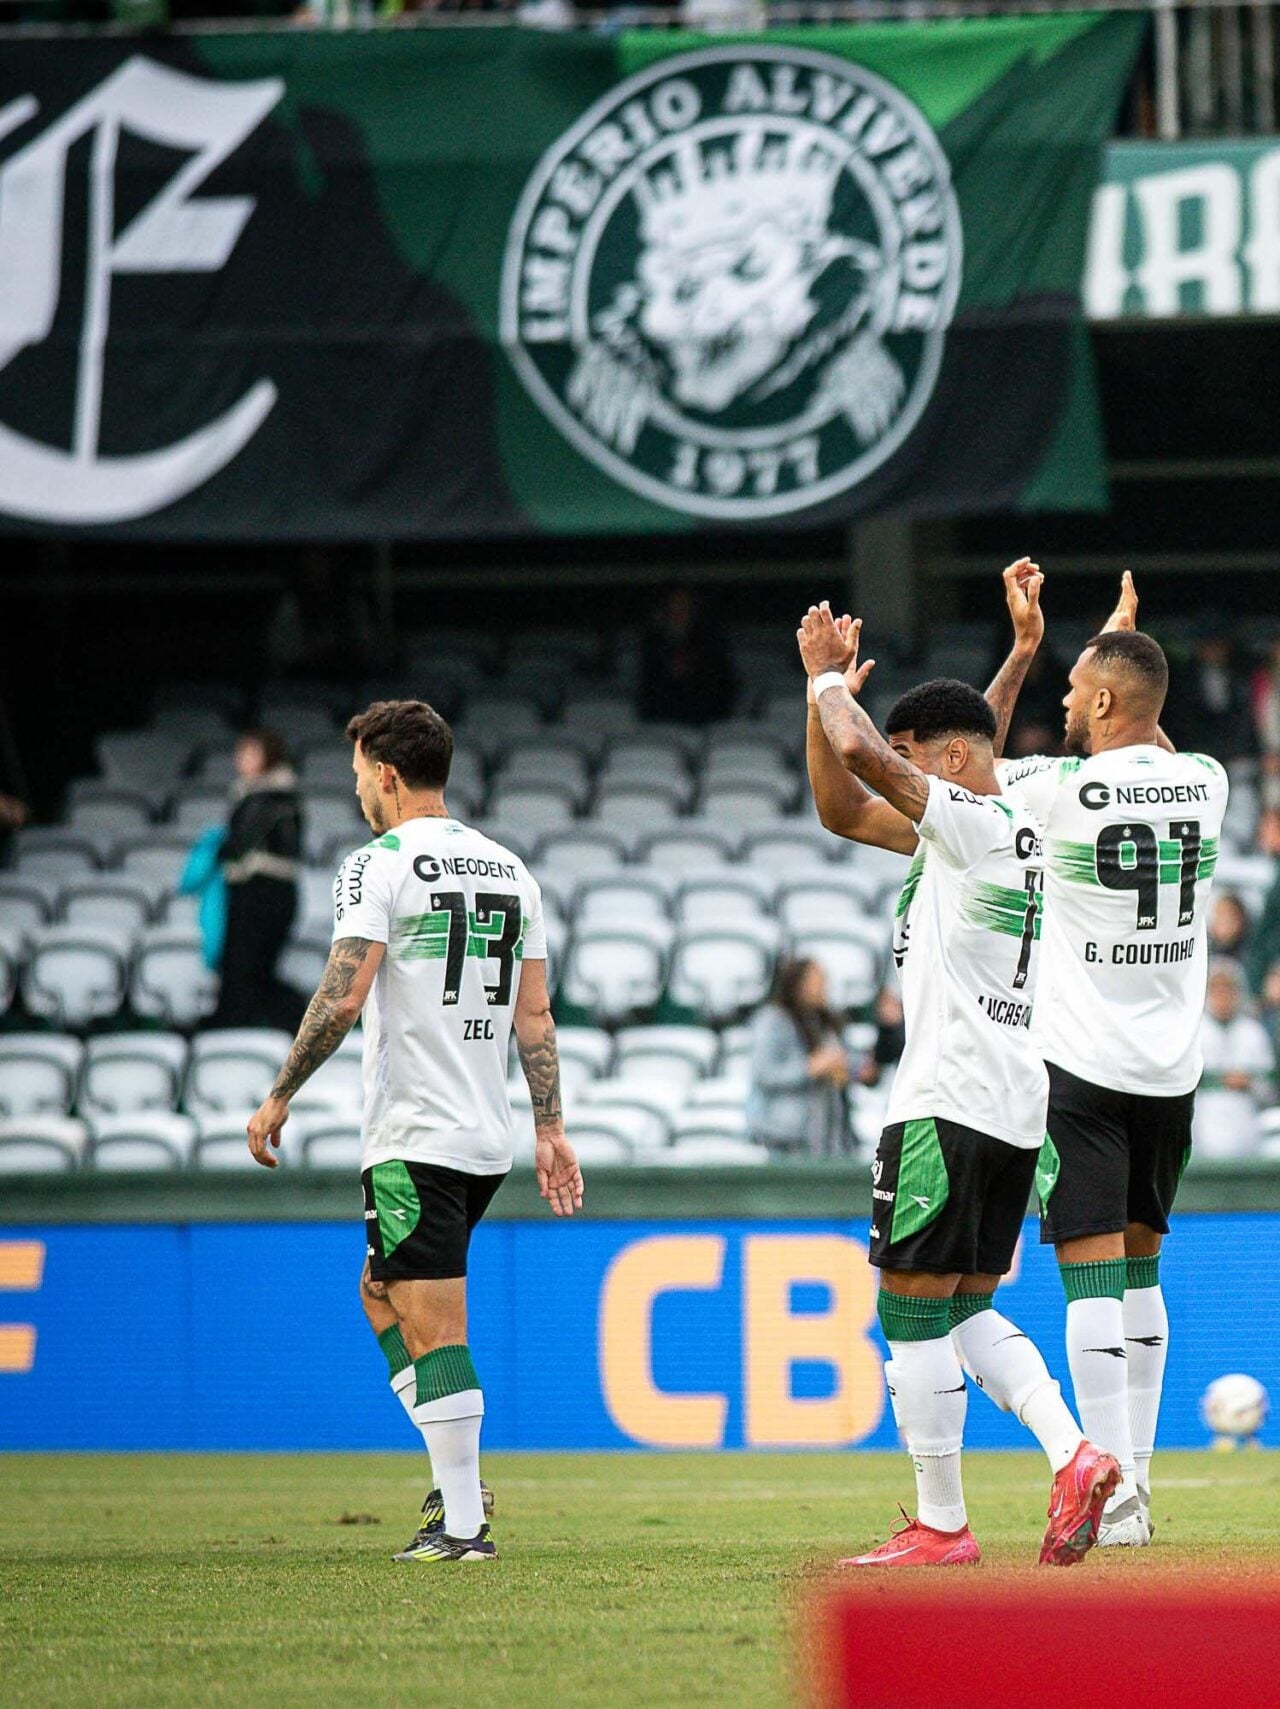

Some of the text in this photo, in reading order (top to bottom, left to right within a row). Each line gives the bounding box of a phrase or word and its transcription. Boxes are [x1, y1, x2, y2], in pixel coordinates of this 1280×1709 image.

[721, 62, 947, 333] ALVIVERDE
[670, 434, 820, 496] 1977
[1096, 820, 1201, 931] 91
[1085, 937, 1195, 965] G. COUTINHO
[598, 1234, 1021, 1448] CB
